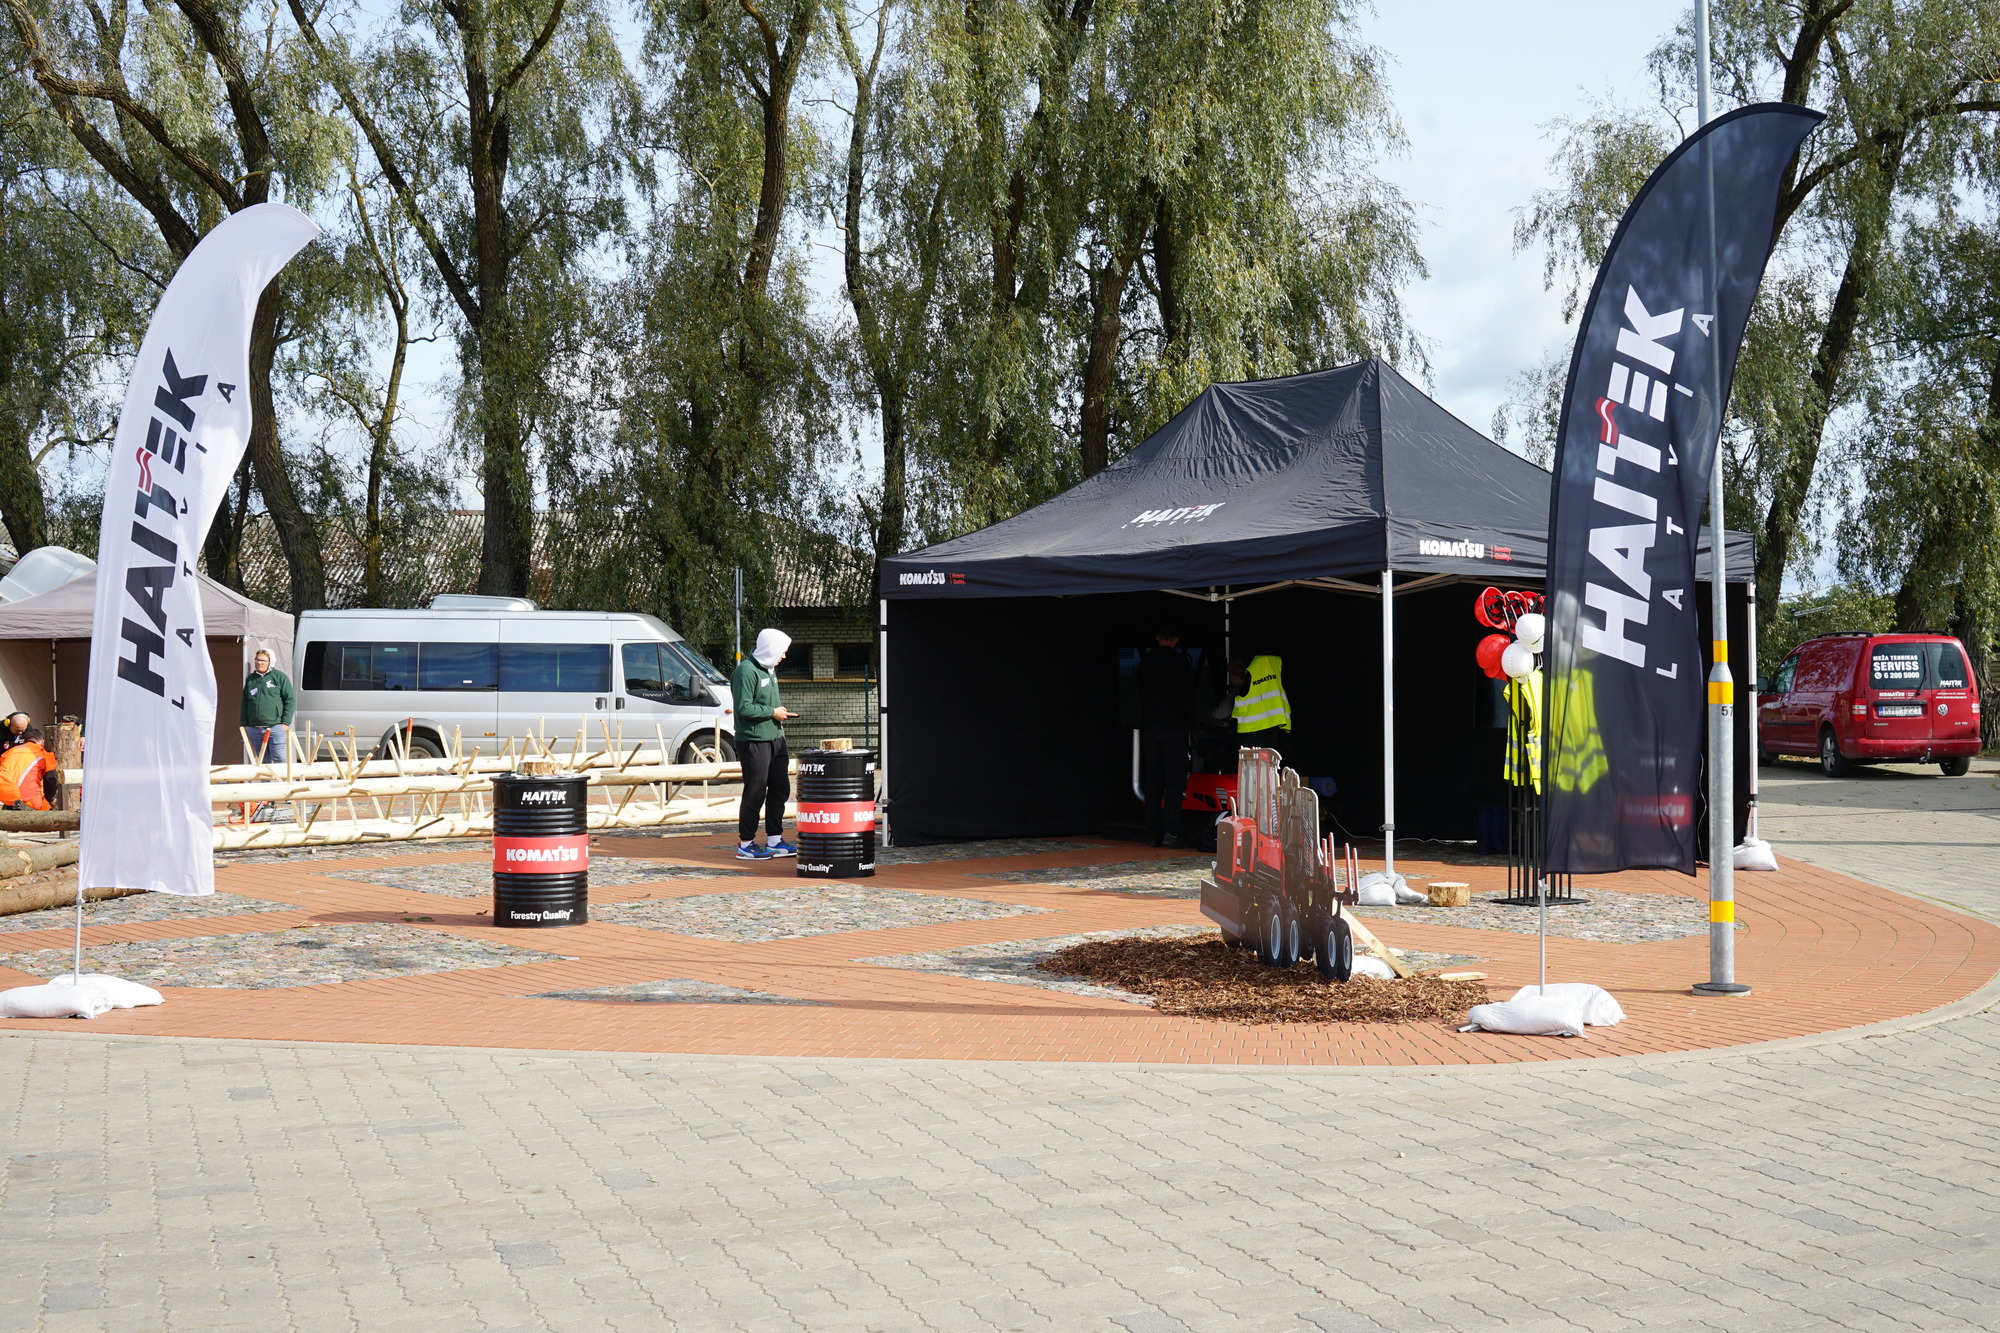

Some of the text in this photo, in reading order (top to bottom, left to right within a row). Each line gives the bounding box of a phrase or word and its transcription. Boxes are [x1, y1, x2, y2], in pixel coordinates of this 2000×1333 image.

[1582, 284, 1684, 668] HAITEK
[1129, 502, 1225, 524] HAITEK
[118, 347, 208, 697] HAITEK
[1419, 539, 1485, 559] KOMATSU
[899, 570, 946, 586] KOMATSU
[1873, 661, 1919, 671] SERVISS
[1252, 674, 1277, 686] KOMATSU
[522, 791, 567, 801] HAITEK
[506, 846, 578, 862] KOMATSU
[510, 911, 542, 922] Forestry
